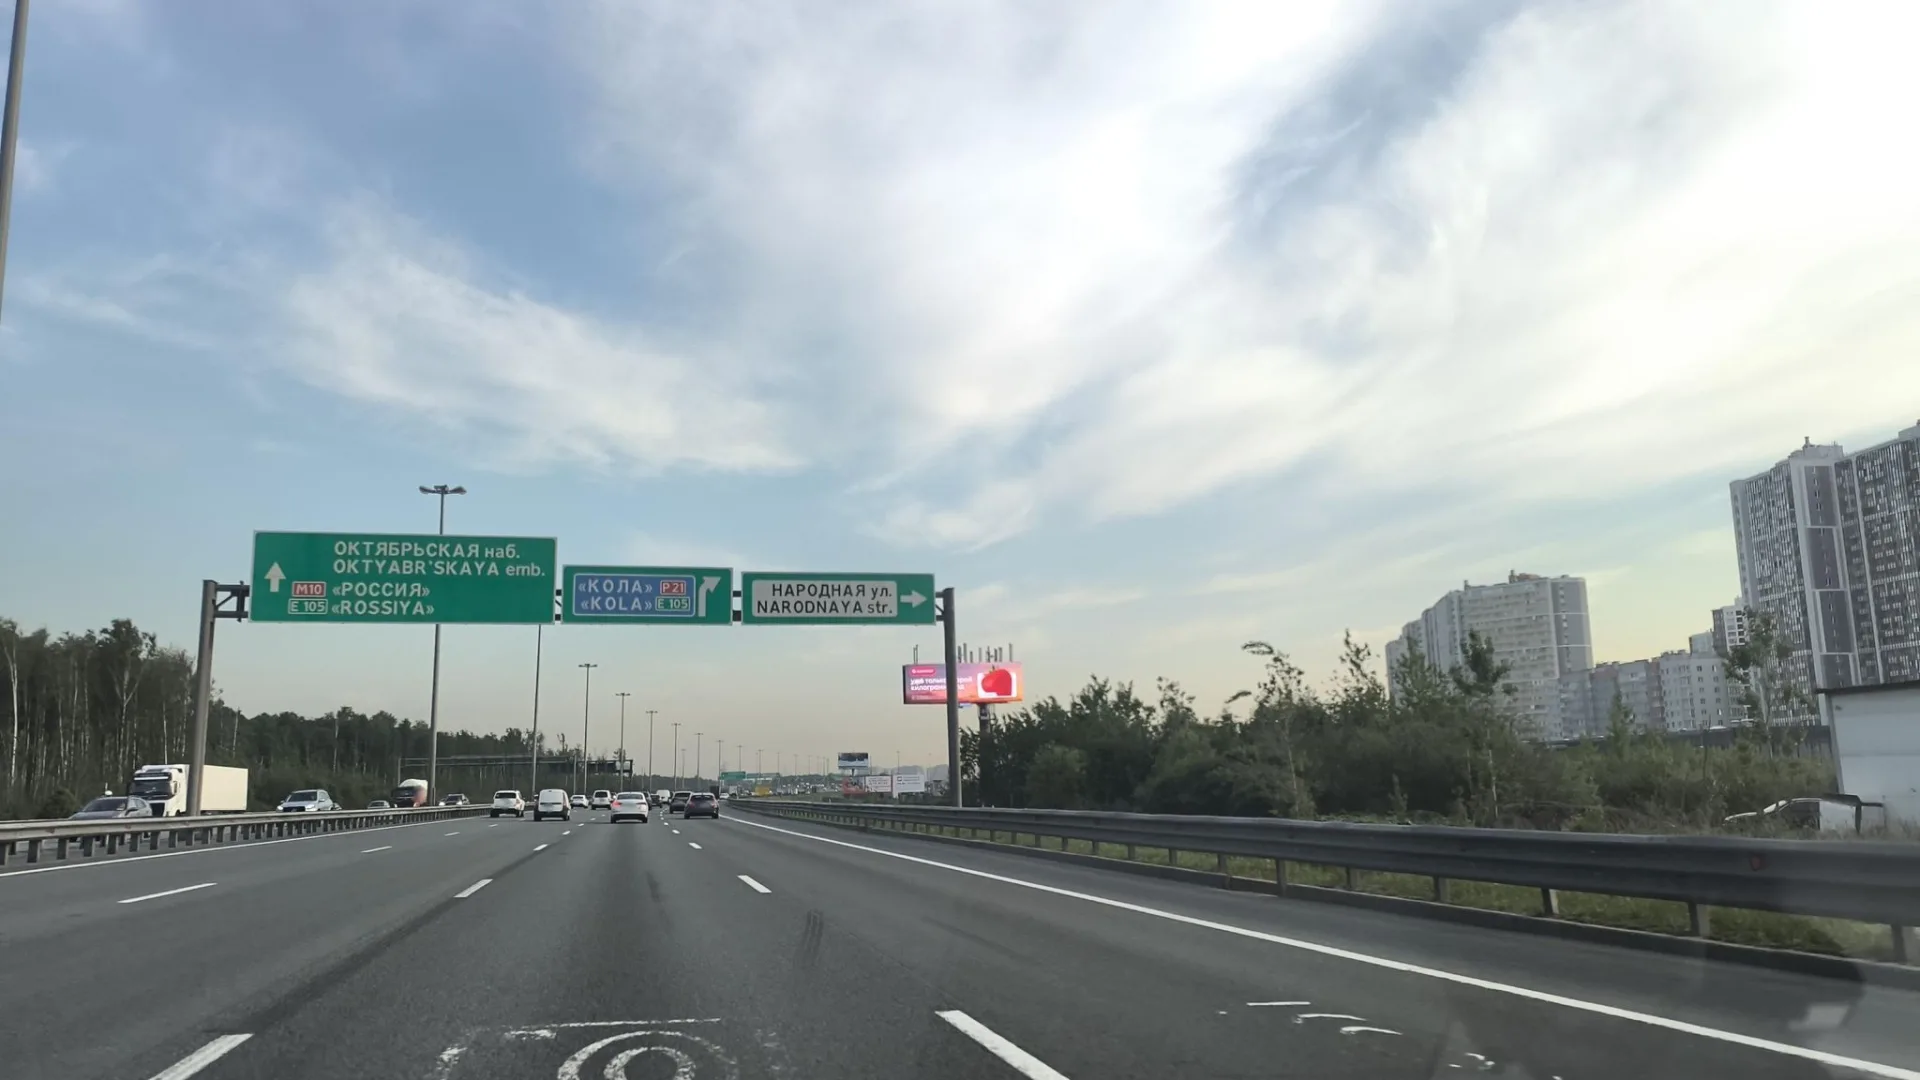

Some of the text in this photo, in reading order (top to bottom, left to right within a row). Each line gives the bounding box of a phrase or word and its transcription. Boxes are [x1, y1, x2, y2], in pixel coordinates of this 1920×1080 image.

[334, 541, 520, 559] ОКТЯБРЬСКАЯ наб.
[505, 562, 545, 577] emb.
[772, 583, 892, 600] НАРОДНАЯ ул.
[303, 601, 325, 612] 105
[757, 600, 893, 614] NARODNAYA str.
